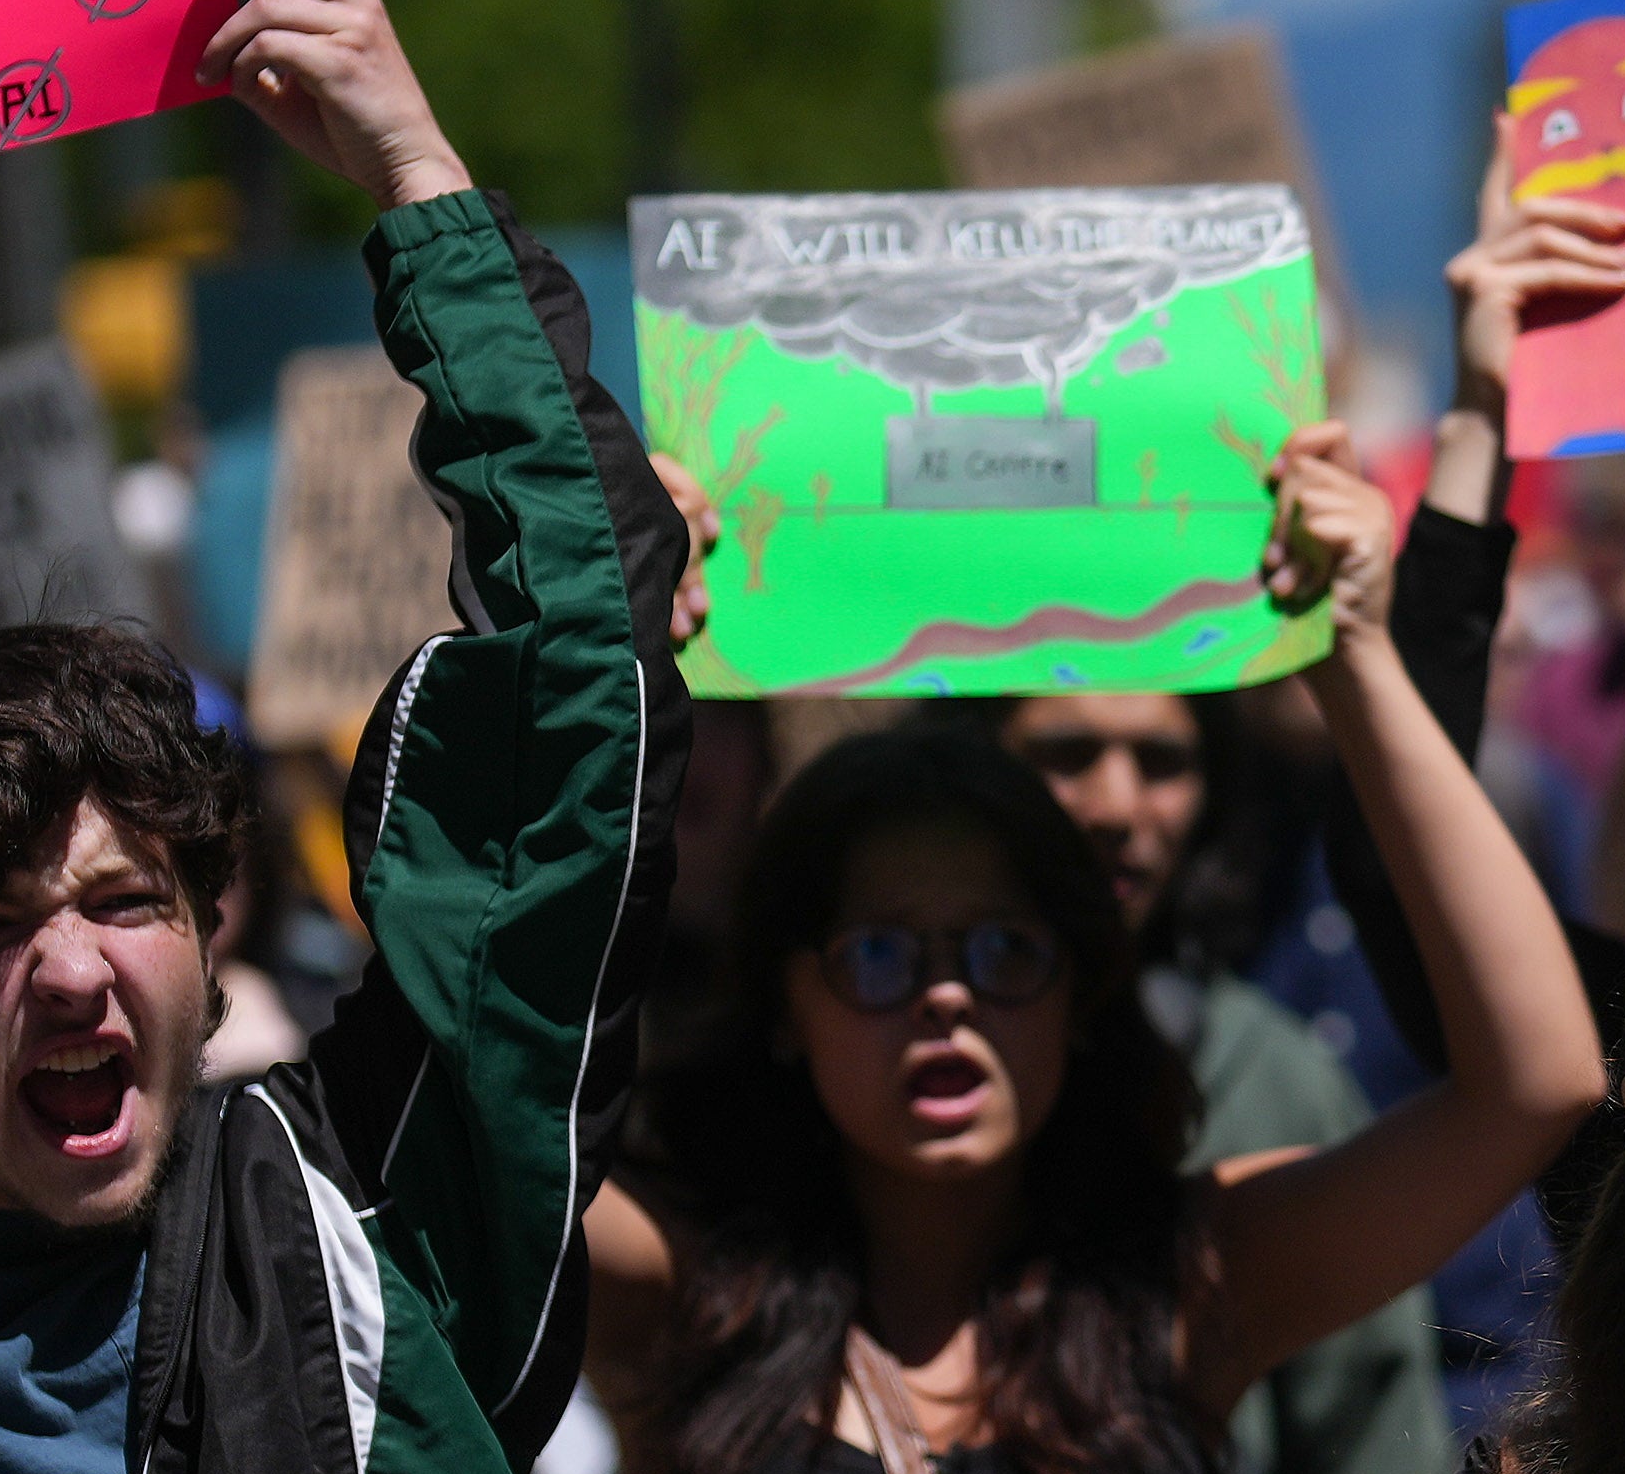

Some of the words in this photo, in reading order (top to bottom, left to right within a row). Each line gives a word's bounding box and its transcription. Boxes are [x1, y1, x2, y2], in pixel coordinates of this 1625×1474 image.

[0, 78, 58, 128] AI
[656, 219, 723, 270] AI
[775, 226, 913, 265] WILL
[948, 221, 1041, 258] KILL
[1154, 215, 1279, 251] PLANET
